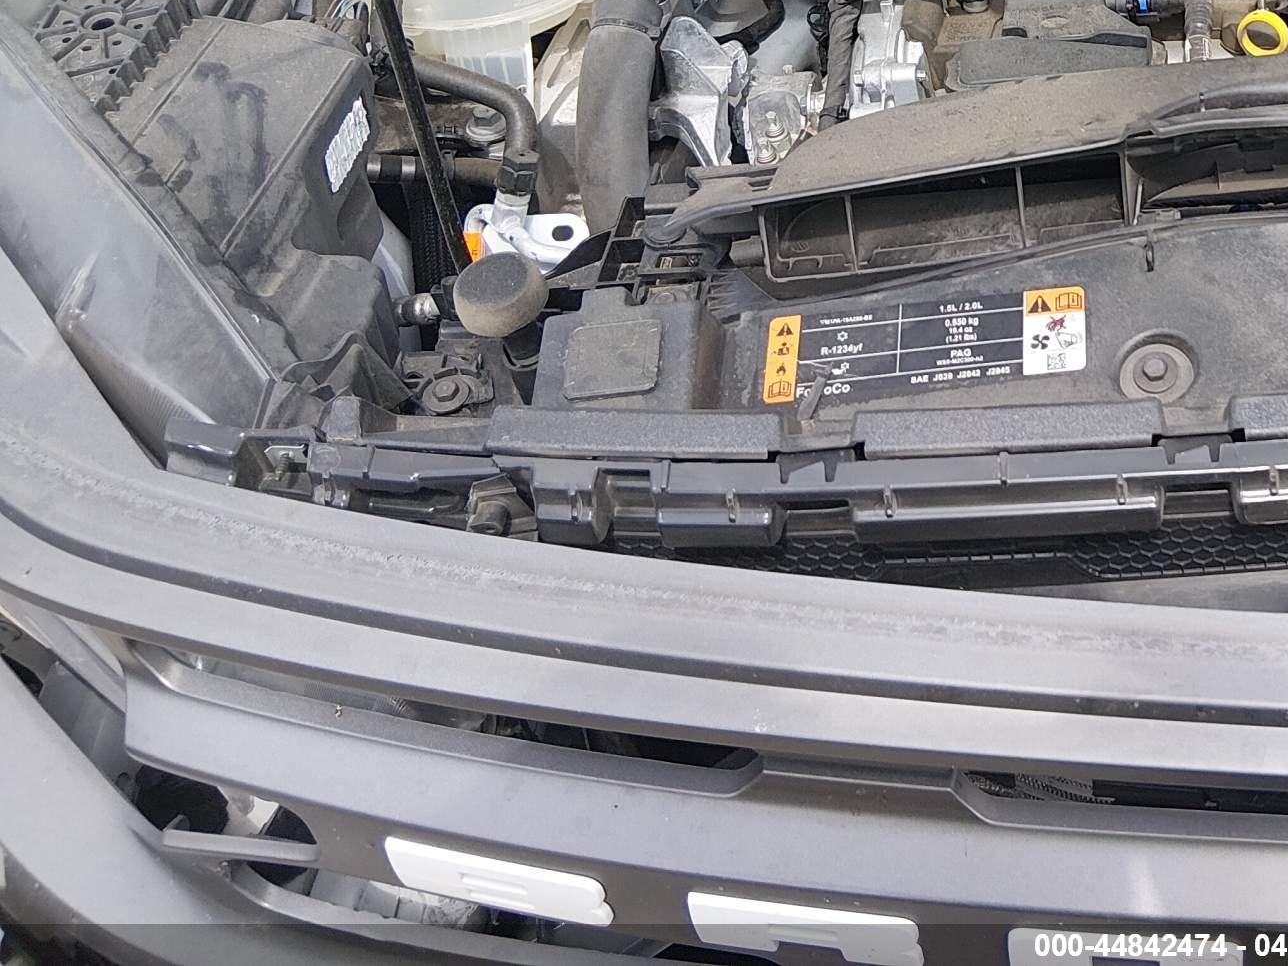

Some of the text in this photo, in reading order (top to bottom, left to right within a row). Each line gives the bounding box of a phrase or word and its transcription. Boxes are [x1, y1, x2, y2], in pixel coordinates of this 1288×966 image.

[964, 302, 983, 310] 2.0L
[968, 317, 979, 326] kg
[820, 342, 864, 356] R-1234yf
[950, 348, 972, 358] PAG
[910, 375, 929, 384] SAE
[796, 383, 850, 398] FooCo
